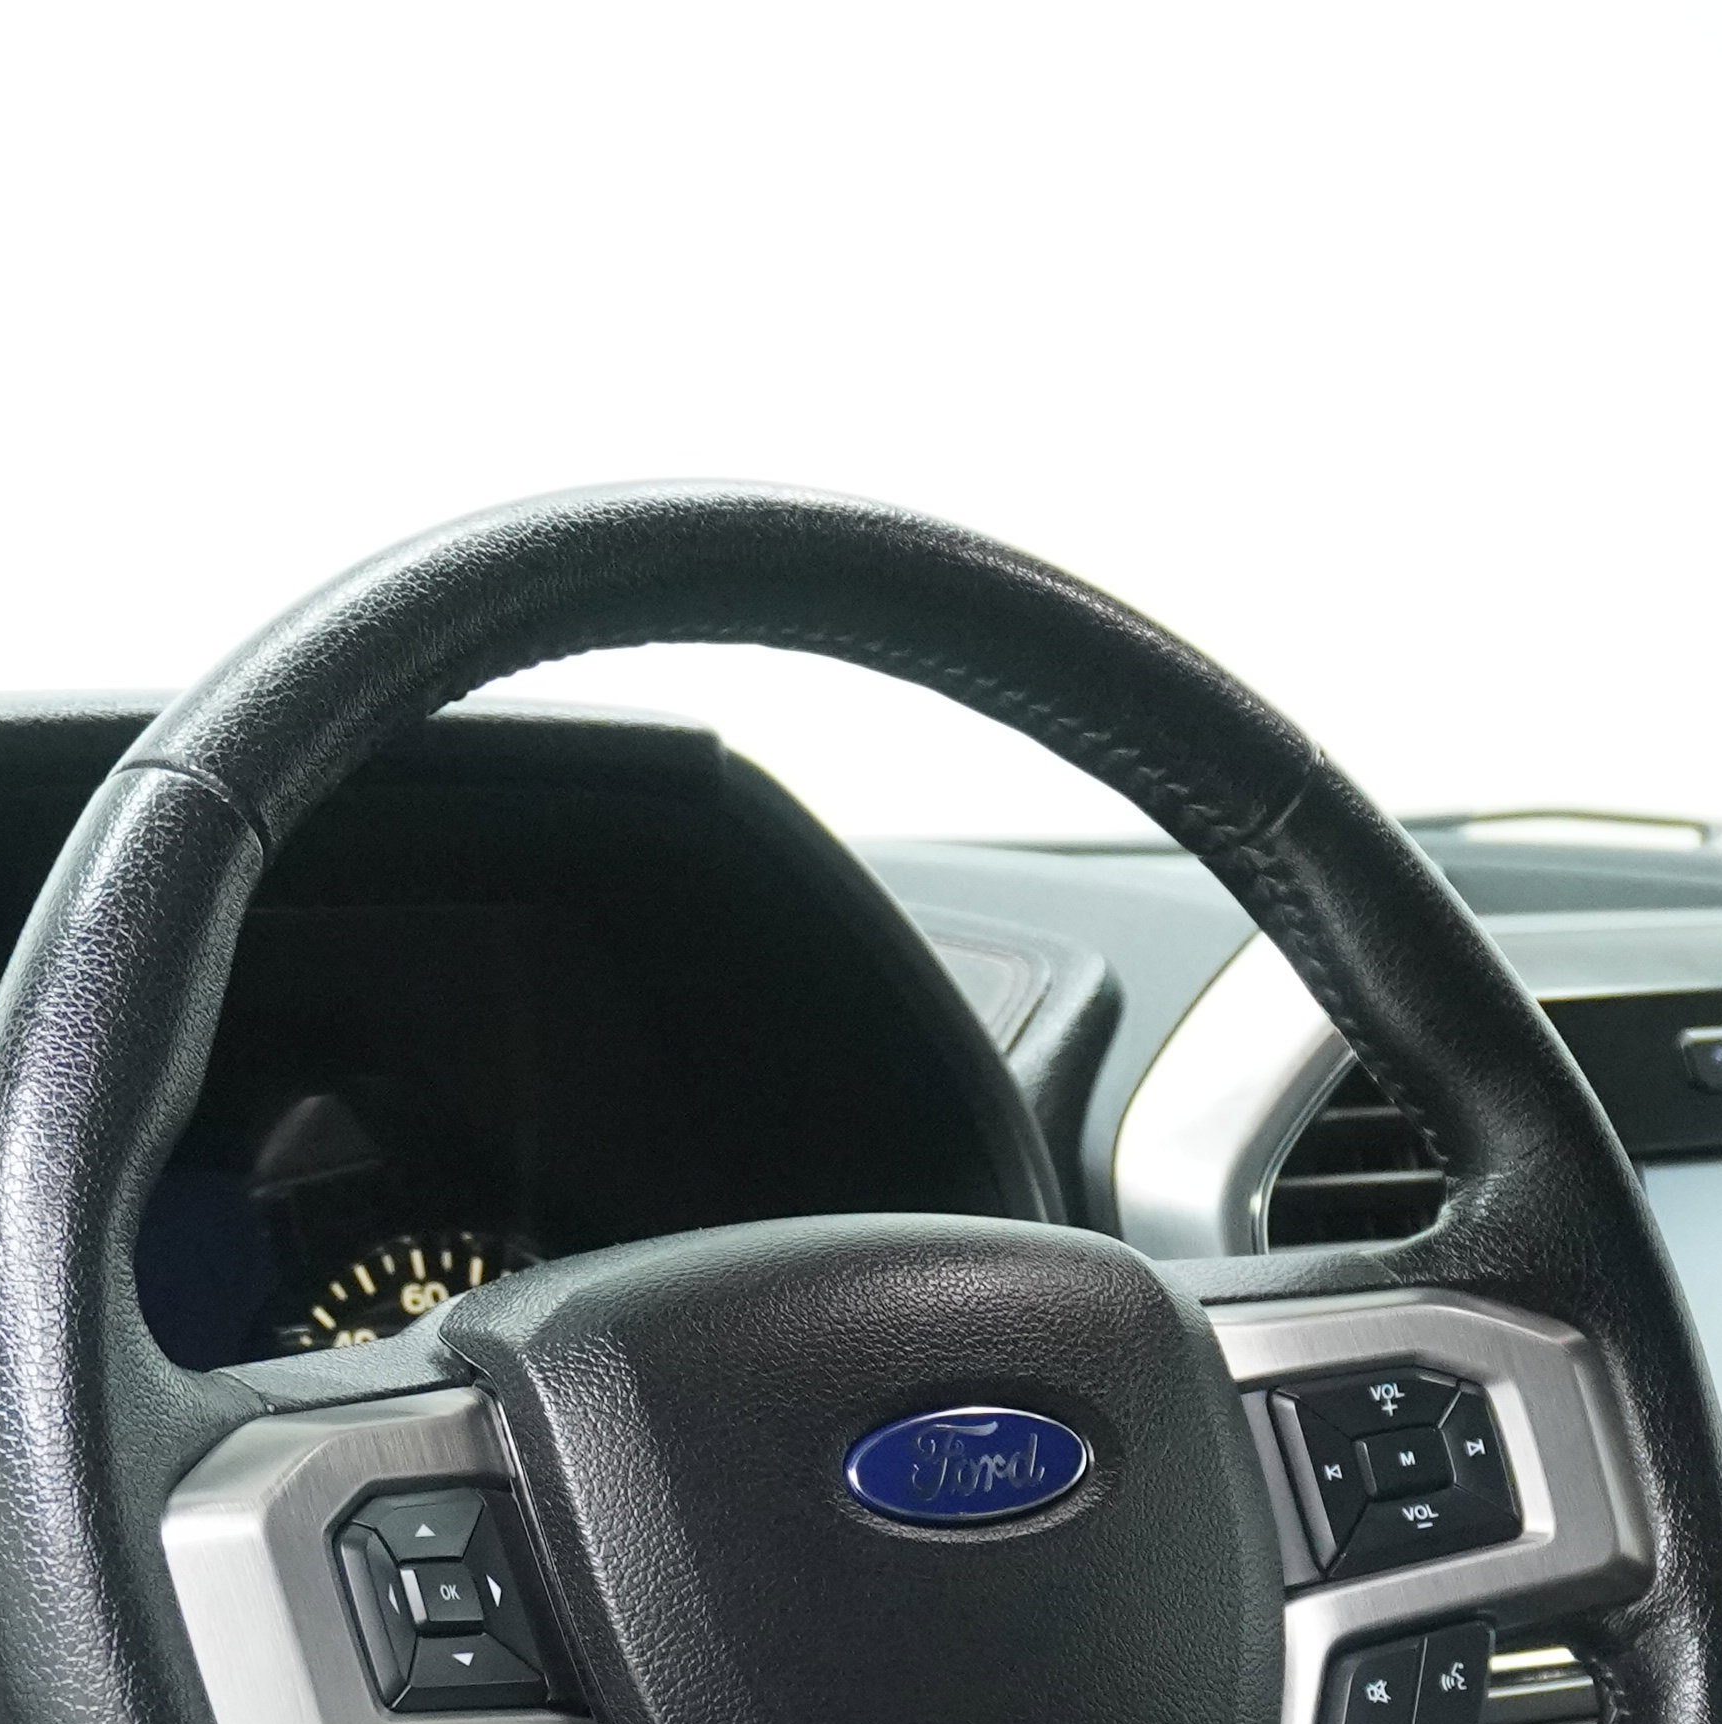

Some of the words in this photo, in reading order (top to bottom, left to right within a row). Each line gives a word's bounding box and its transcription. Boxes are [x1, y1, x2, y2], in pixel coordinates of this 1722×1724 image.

[1369, 1382, 1406, 1402] VOL
[911, 1419, 1047, 1502] Ford
[1398, 1449, 1417, 1468] M
[1401, 1502, 1440, 1522] VOL
[439, 1583, 461, 1601] OK
